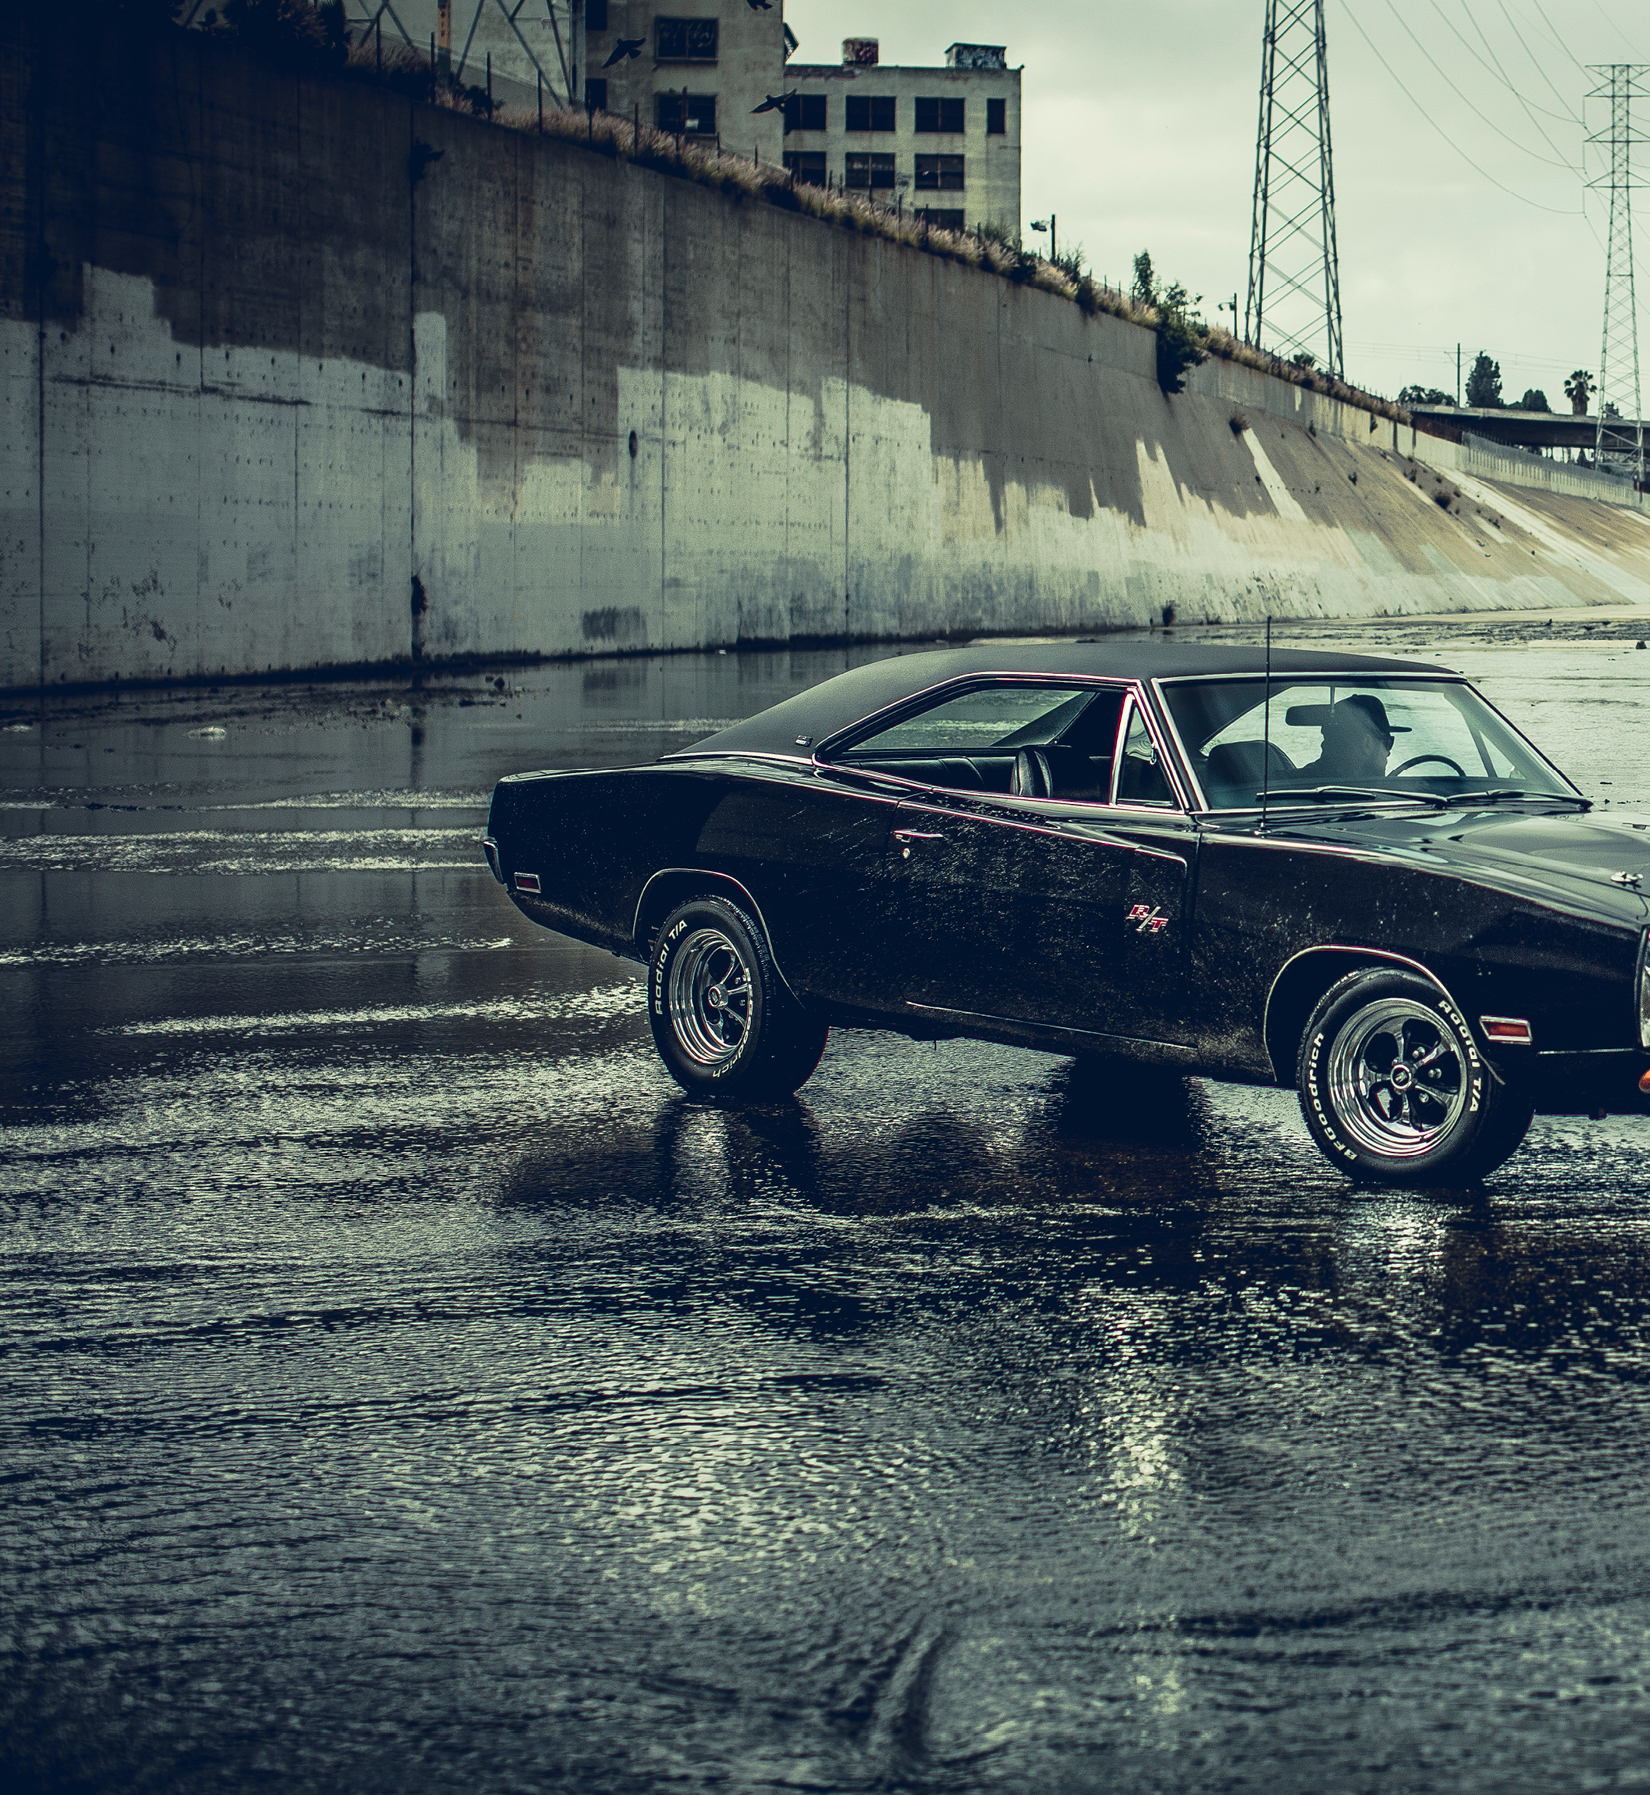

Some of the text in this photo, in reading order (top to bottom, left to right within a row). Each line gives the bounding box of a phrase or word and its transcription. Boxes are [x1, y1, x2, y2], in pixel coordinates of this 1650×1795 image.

[654, 919, 688, 1015] Radial T/A
[1128, 904, 1169, 931] R/T
[1308, 1032, 1358, 1161] BFGoodrich
[1438, 1000, 1482, 1112] Radial T/A
